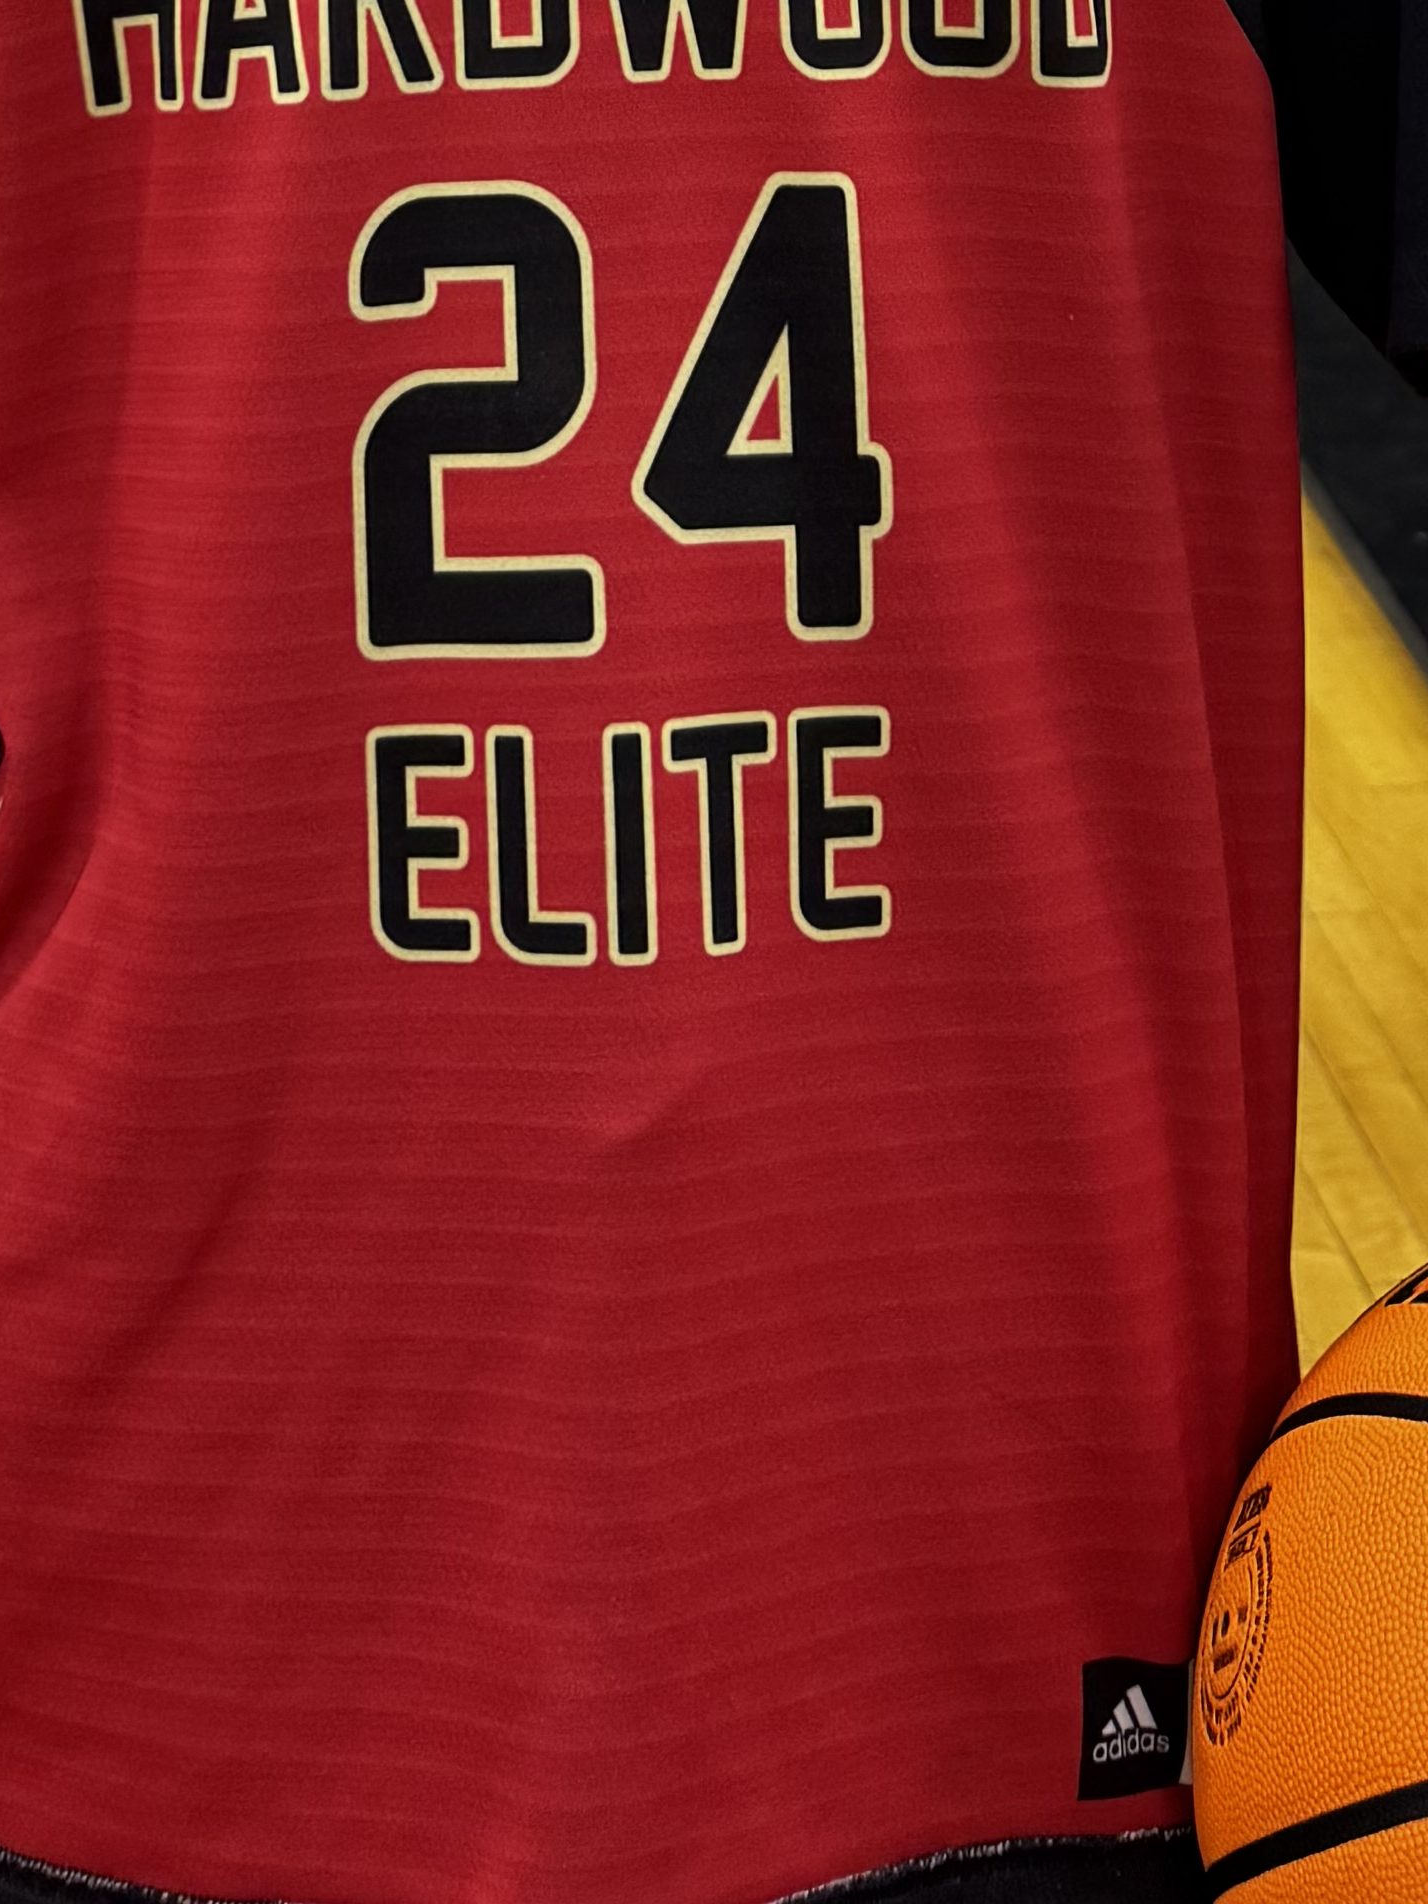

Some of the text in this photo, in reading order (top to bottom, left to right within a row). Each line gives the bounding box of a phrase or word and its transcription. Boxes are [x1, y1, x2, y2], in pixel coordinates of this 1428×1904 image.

[349, 171, 892, 660] 24
[366, 705, 892, 965] ELITE
[1093, 1729, 1170, 1763] adidas
